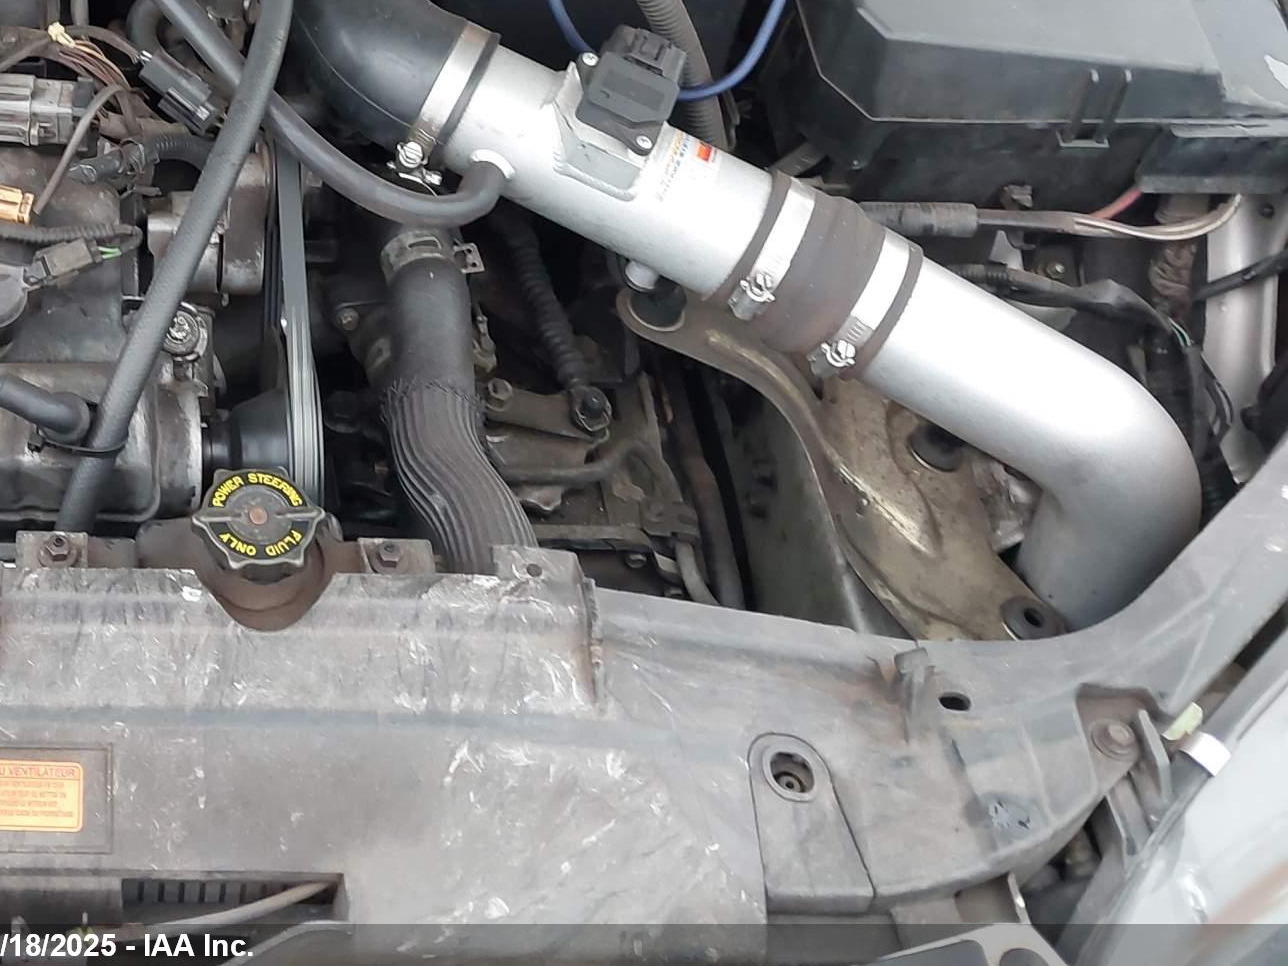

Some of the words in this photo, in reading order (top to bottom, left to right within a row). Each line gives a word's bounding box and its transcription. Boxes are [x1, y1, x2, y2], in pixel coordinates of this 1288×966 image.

[212, 476, 244, 507] POWER
[248, 473, 302, 506] STEERING
[219, 533, 256, 556] ONLY
[265, 530, 302, 556] FLUID
[6, 766, 75, 778] VENTILATEUR
